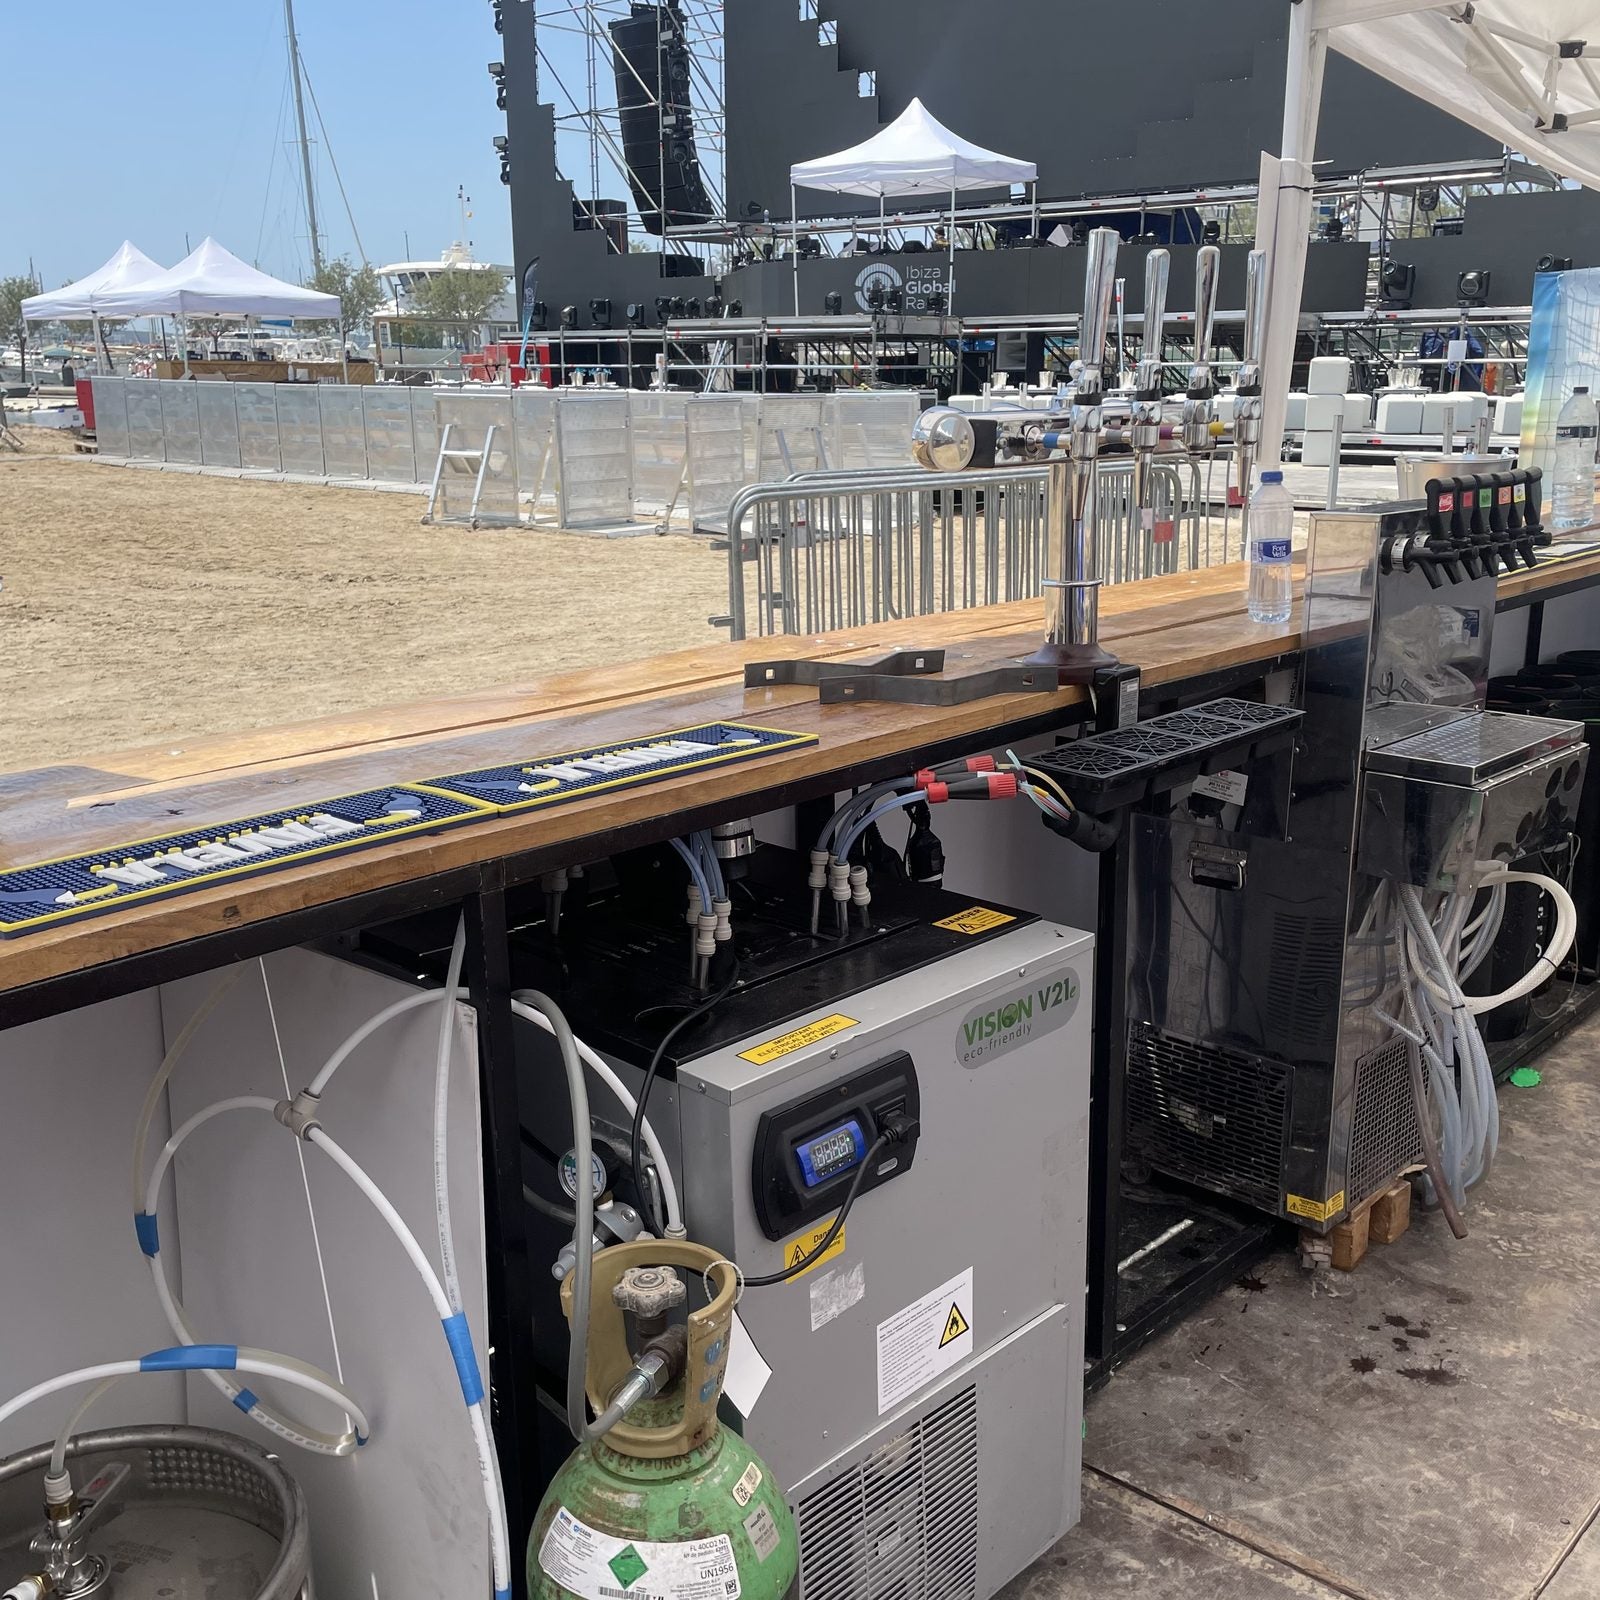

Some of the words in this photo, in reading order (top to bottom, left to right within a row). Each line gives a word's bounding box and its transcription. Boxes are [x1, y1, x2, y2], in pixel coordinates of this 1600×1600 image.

[905, 265, 942, 279] Ibiza
[905, 279, 956, 294] Global
[905, 296, 950, 310] Rao
[941, 907, 984, 926] DANGER
[963, 995, 1033, 1046] VISION
[773, 1026, 813, 1046] IMPORTANT
[801, 1020, 841, 1040] APPLIANCE
[776, 1047, 789, 1055] DO
[789, 1041, 803, 1050] NOT
[963, 1023, 1032, 1062] eco-friendly
[700, 1562, 734, 1580] UN1956
